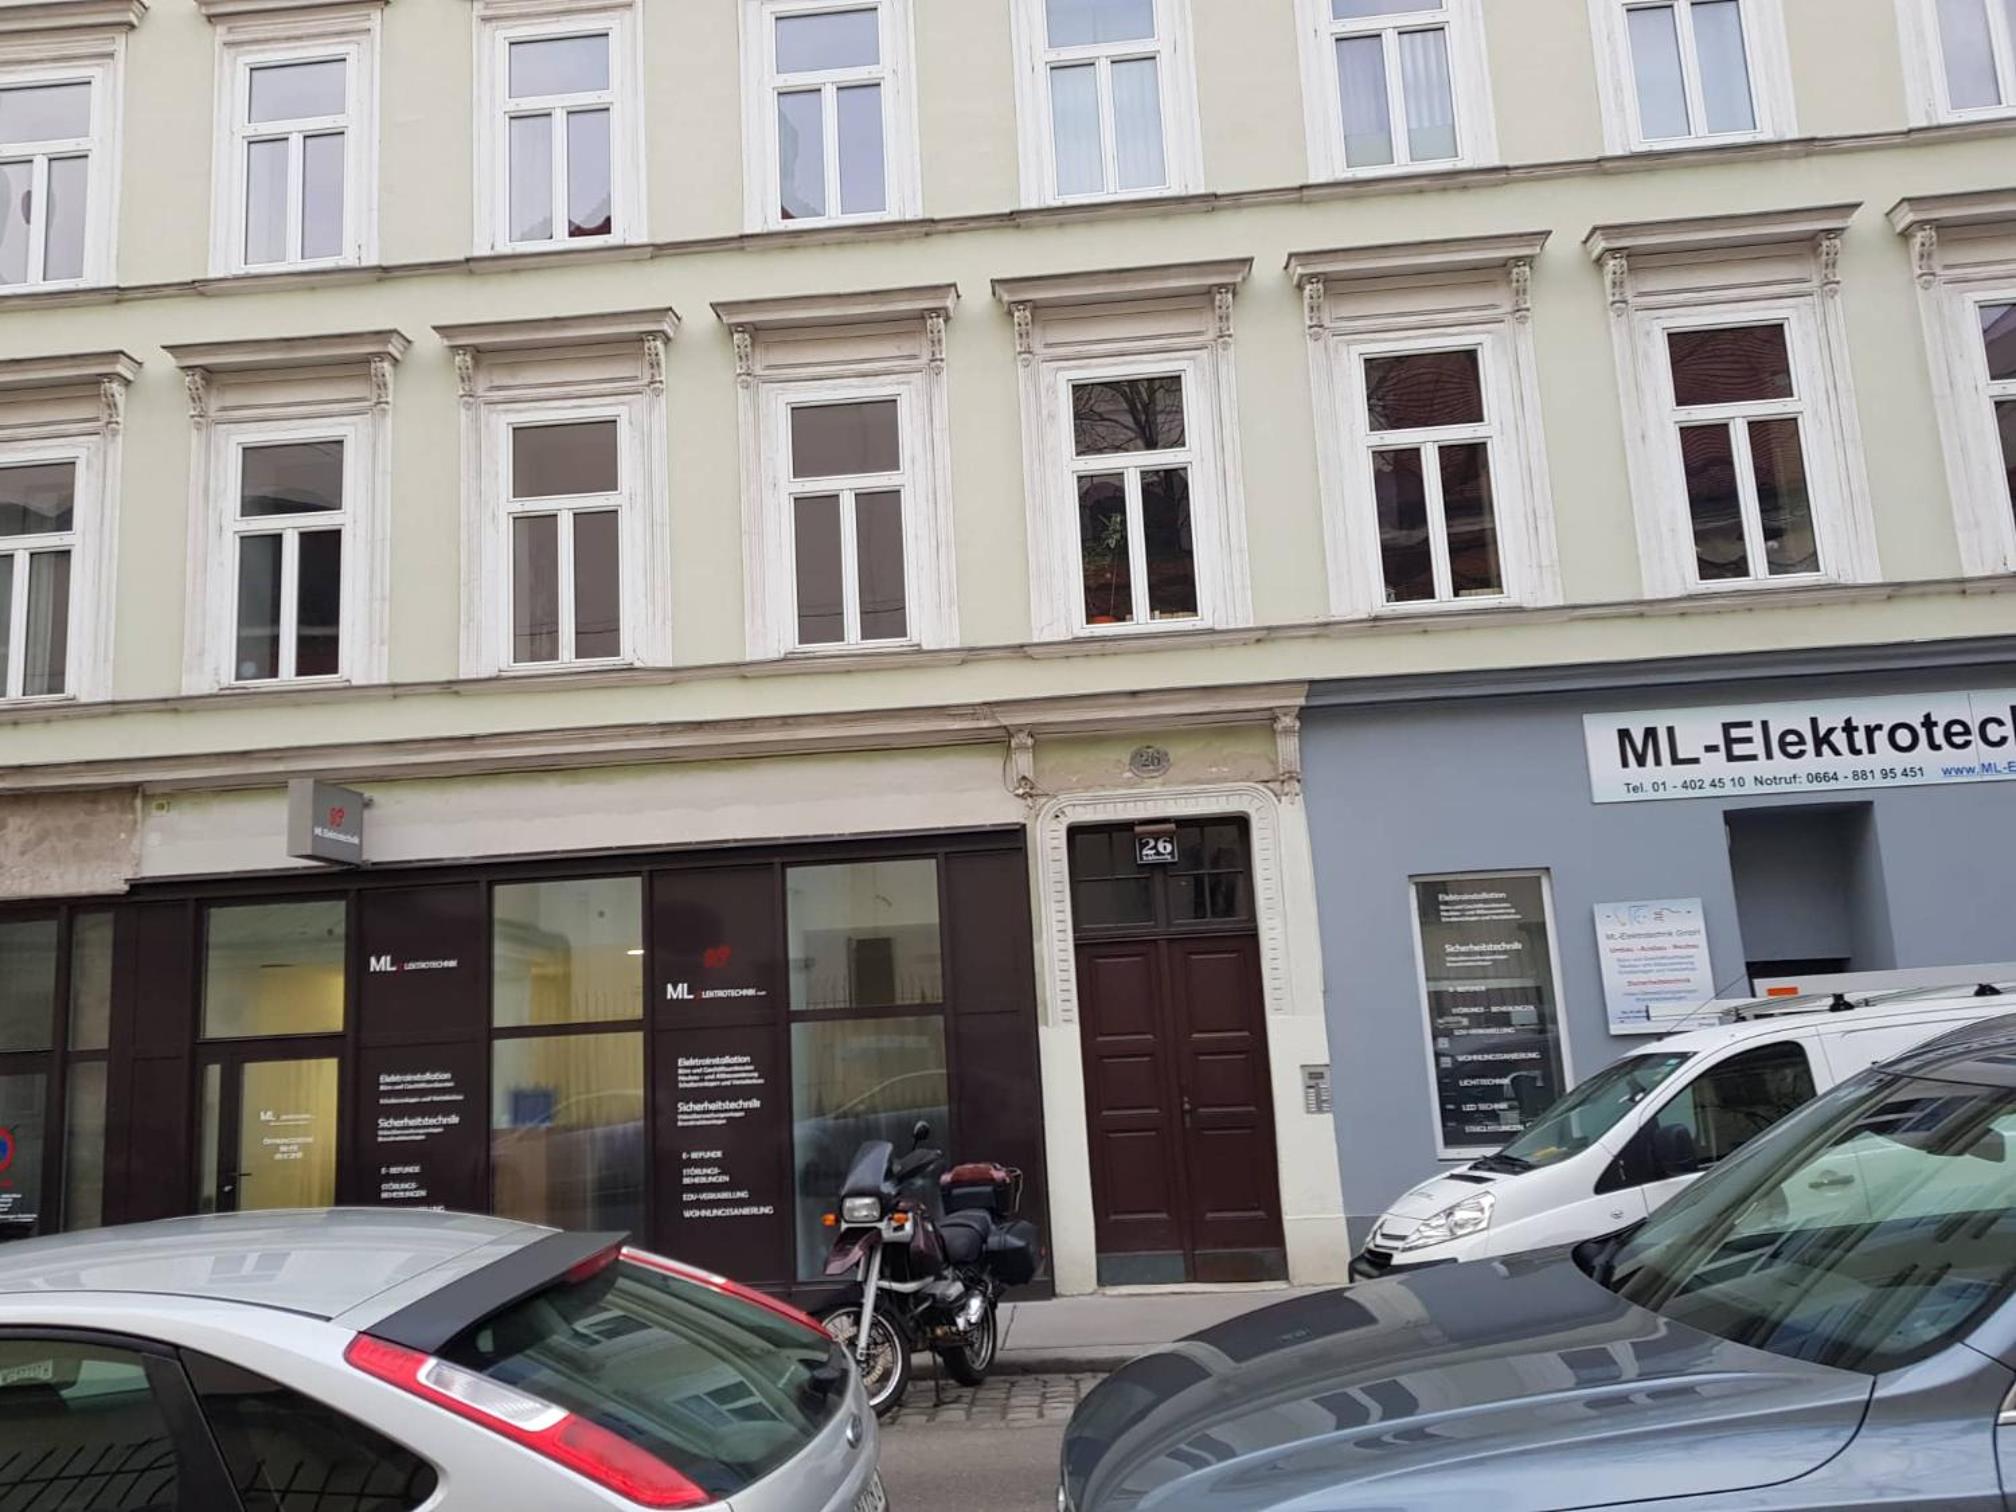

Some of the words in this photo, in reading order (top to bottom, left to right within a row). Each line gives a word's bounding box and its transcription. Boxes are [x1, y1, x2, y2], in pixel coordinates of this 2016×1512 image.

[1617, 704, 2016, 769] ML-Elektrotec
[1140, 749, 1161, 768] 26
[1624, 782, 1647, 794] Tel.
[1652, 780, 1667, 792] 01
[1681, 779, 1705, 791] 402
[1709, 777, 1726, 789] 45
[1730, 776, 1746, 788] 10
[1754, 773, 1803, 787] Notruf:
[1806, 770, 1839, 784] 0664
[1852, 769, 1875, 782] 881
[1881, 767, 1897, 779] 95
[1901, 766, 1924, 779] 451
[1141, 837, 1173, 856] 26
[370, 955, 397, 972] ML
[667, 982, 694, 1000] ML
[678, 1098, 761, 1113] Sicherheitstechnik
[377, 1114, 460, 1129] Sicherheitstechnik
[682, 1205, 775, 1218] WOHNUNGSSANIERUNG
